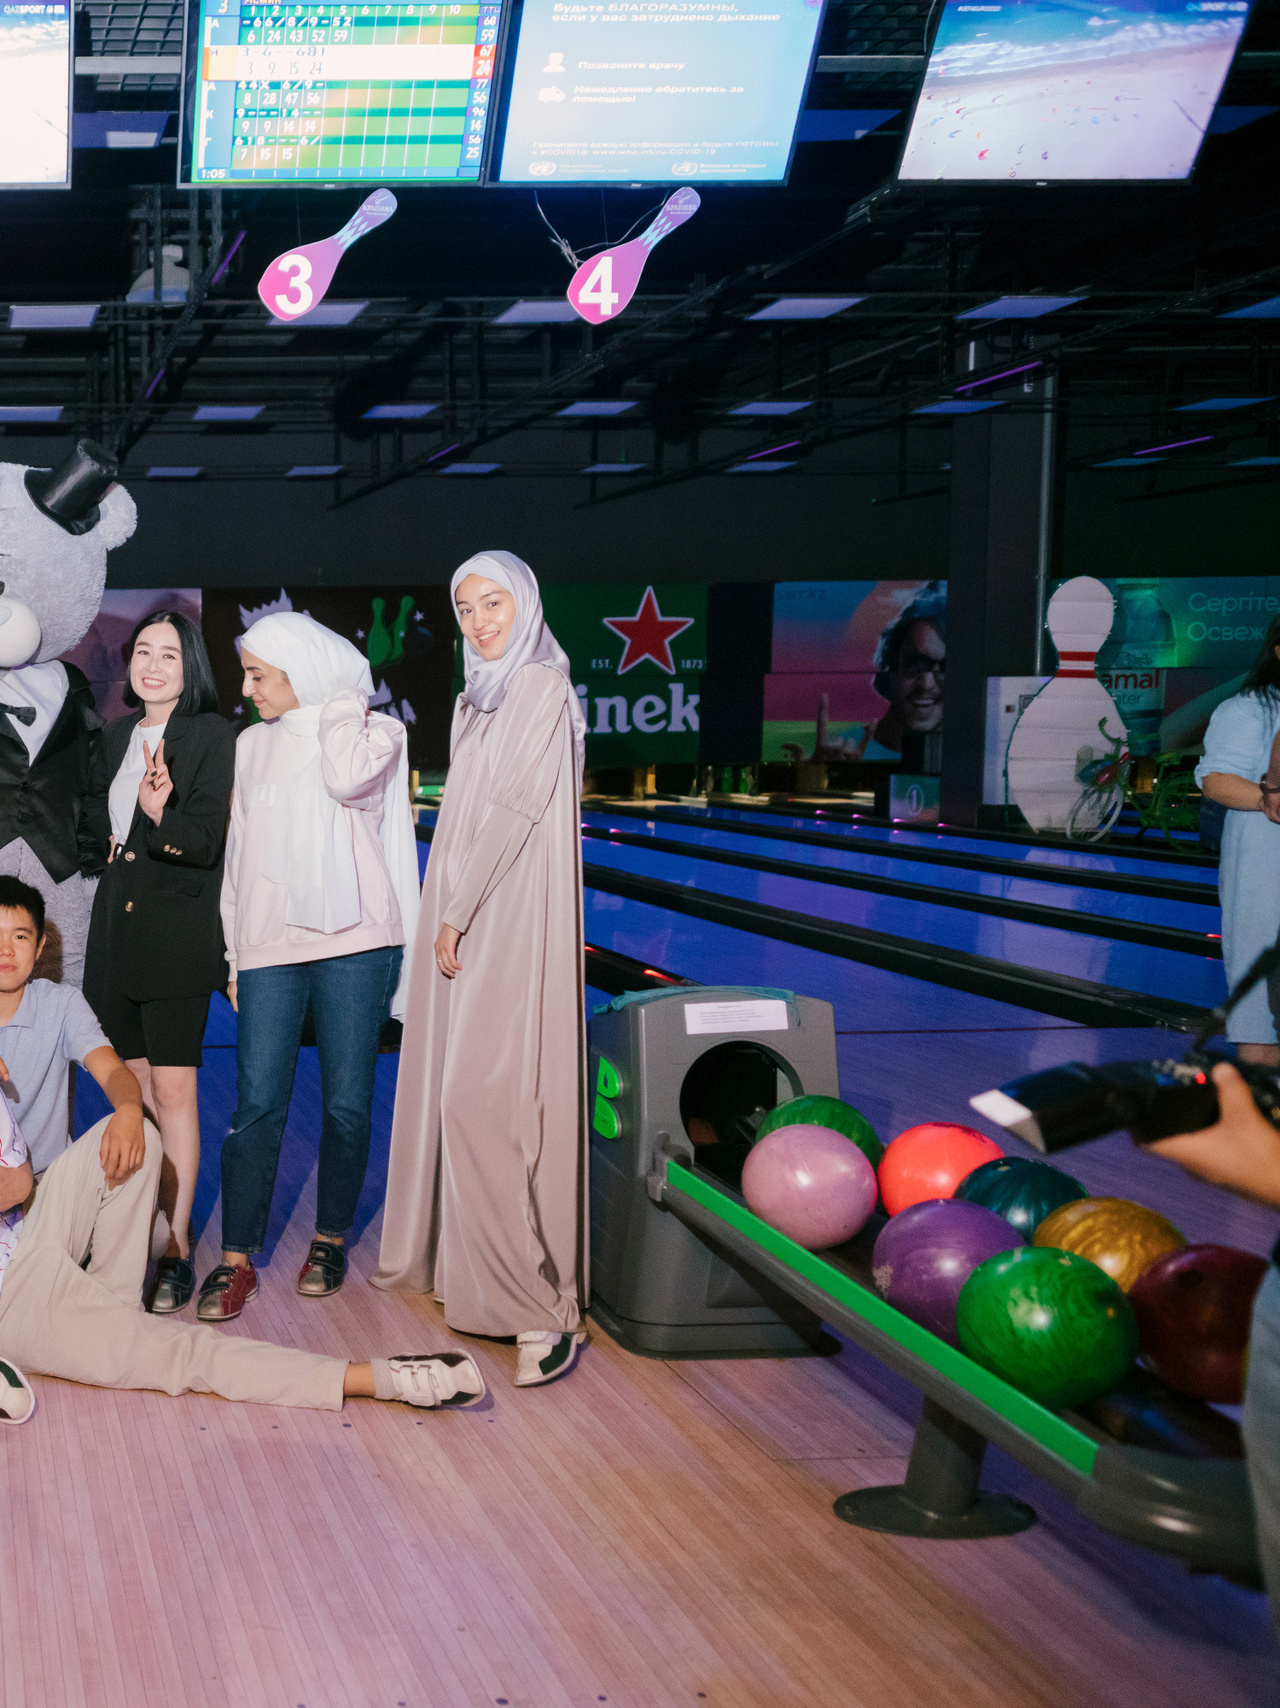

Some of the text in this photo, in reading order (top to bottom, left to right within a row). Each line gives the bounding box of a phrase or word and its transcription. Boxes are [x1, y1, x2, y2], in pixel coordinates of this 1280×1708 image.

[3, 4, 46, 14] QAZSPORT
[553, 3, 738, 13] Будьте БЛАГОРАЗУМНЫ,
[590, 15, 599, 23] у
[631, 14, 714, 23] затруднено
[717, 14, 781, 22] дыхание
[247, 29, 496, 43] 6 24 43 52 59 59
[578, 61, 685, 70] Позвоните врачу
[655, 85, 727, 94] обратитесь
[243, 92, 487, 105] 8 28 47 56 56
[470, 119, 482, 132] 14
[466, 146, 480, 159] 25
[201, 169, 226, 178] 1:05
[274, 254, 314, 316] 3
[578, 256, 618, 316] 4
[1187, 622, 1268, 641] Освеж
[591, 659, 703, 669] EST. 1873
[575, 682, 700, 734] inek
